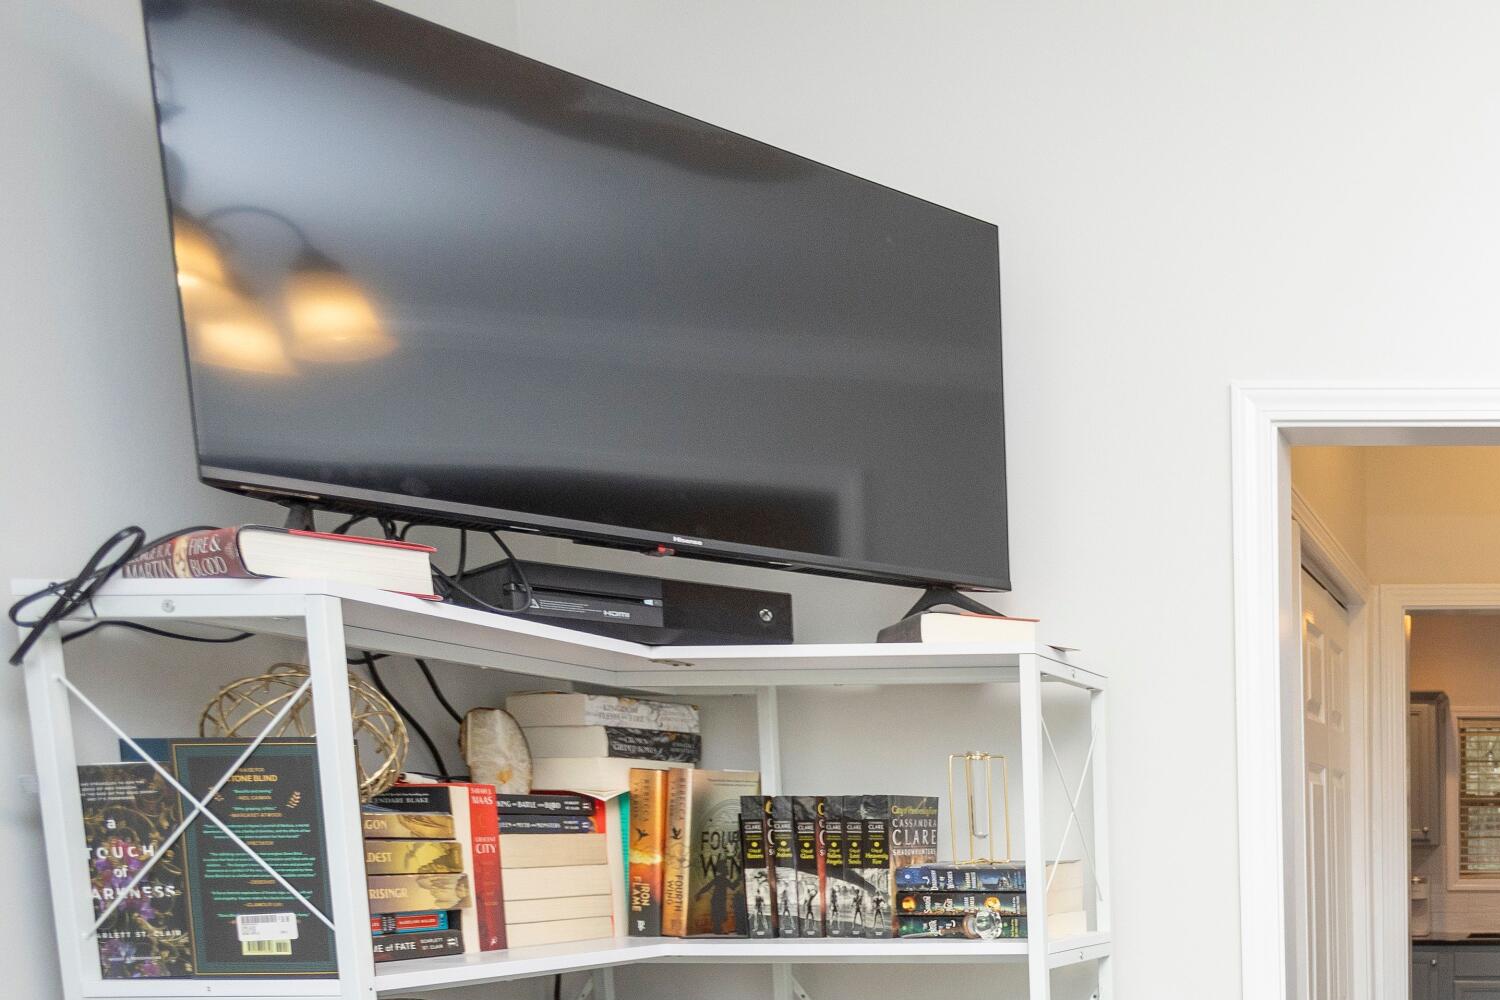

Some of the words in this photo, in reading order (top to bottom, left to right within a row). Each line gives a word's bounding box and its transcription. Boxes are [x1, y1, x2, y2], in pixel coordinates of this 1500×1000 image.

[672, 535, 703, 546] Hisense
[188, 556, 228, 577] BLOOD
[603, 609, 631, 619] HDMI
[253, 774, 278, 783] BLIND
[471, 795, 495, 805] MAAS
[106, 818, 117, 830] a
[892, 819, 937, 828] CASSANDRA
[892, 829, 937, 846] CLARE
[475, 843, 497, 854] CITY
[113, 865, 129, 879] of
[92, 885, 177, 901] ARKNESS
[641, 883, 651, 906] IRON
[675, 874, 684, 912] FOURTH
[394, 941, 417, 951] FATE
